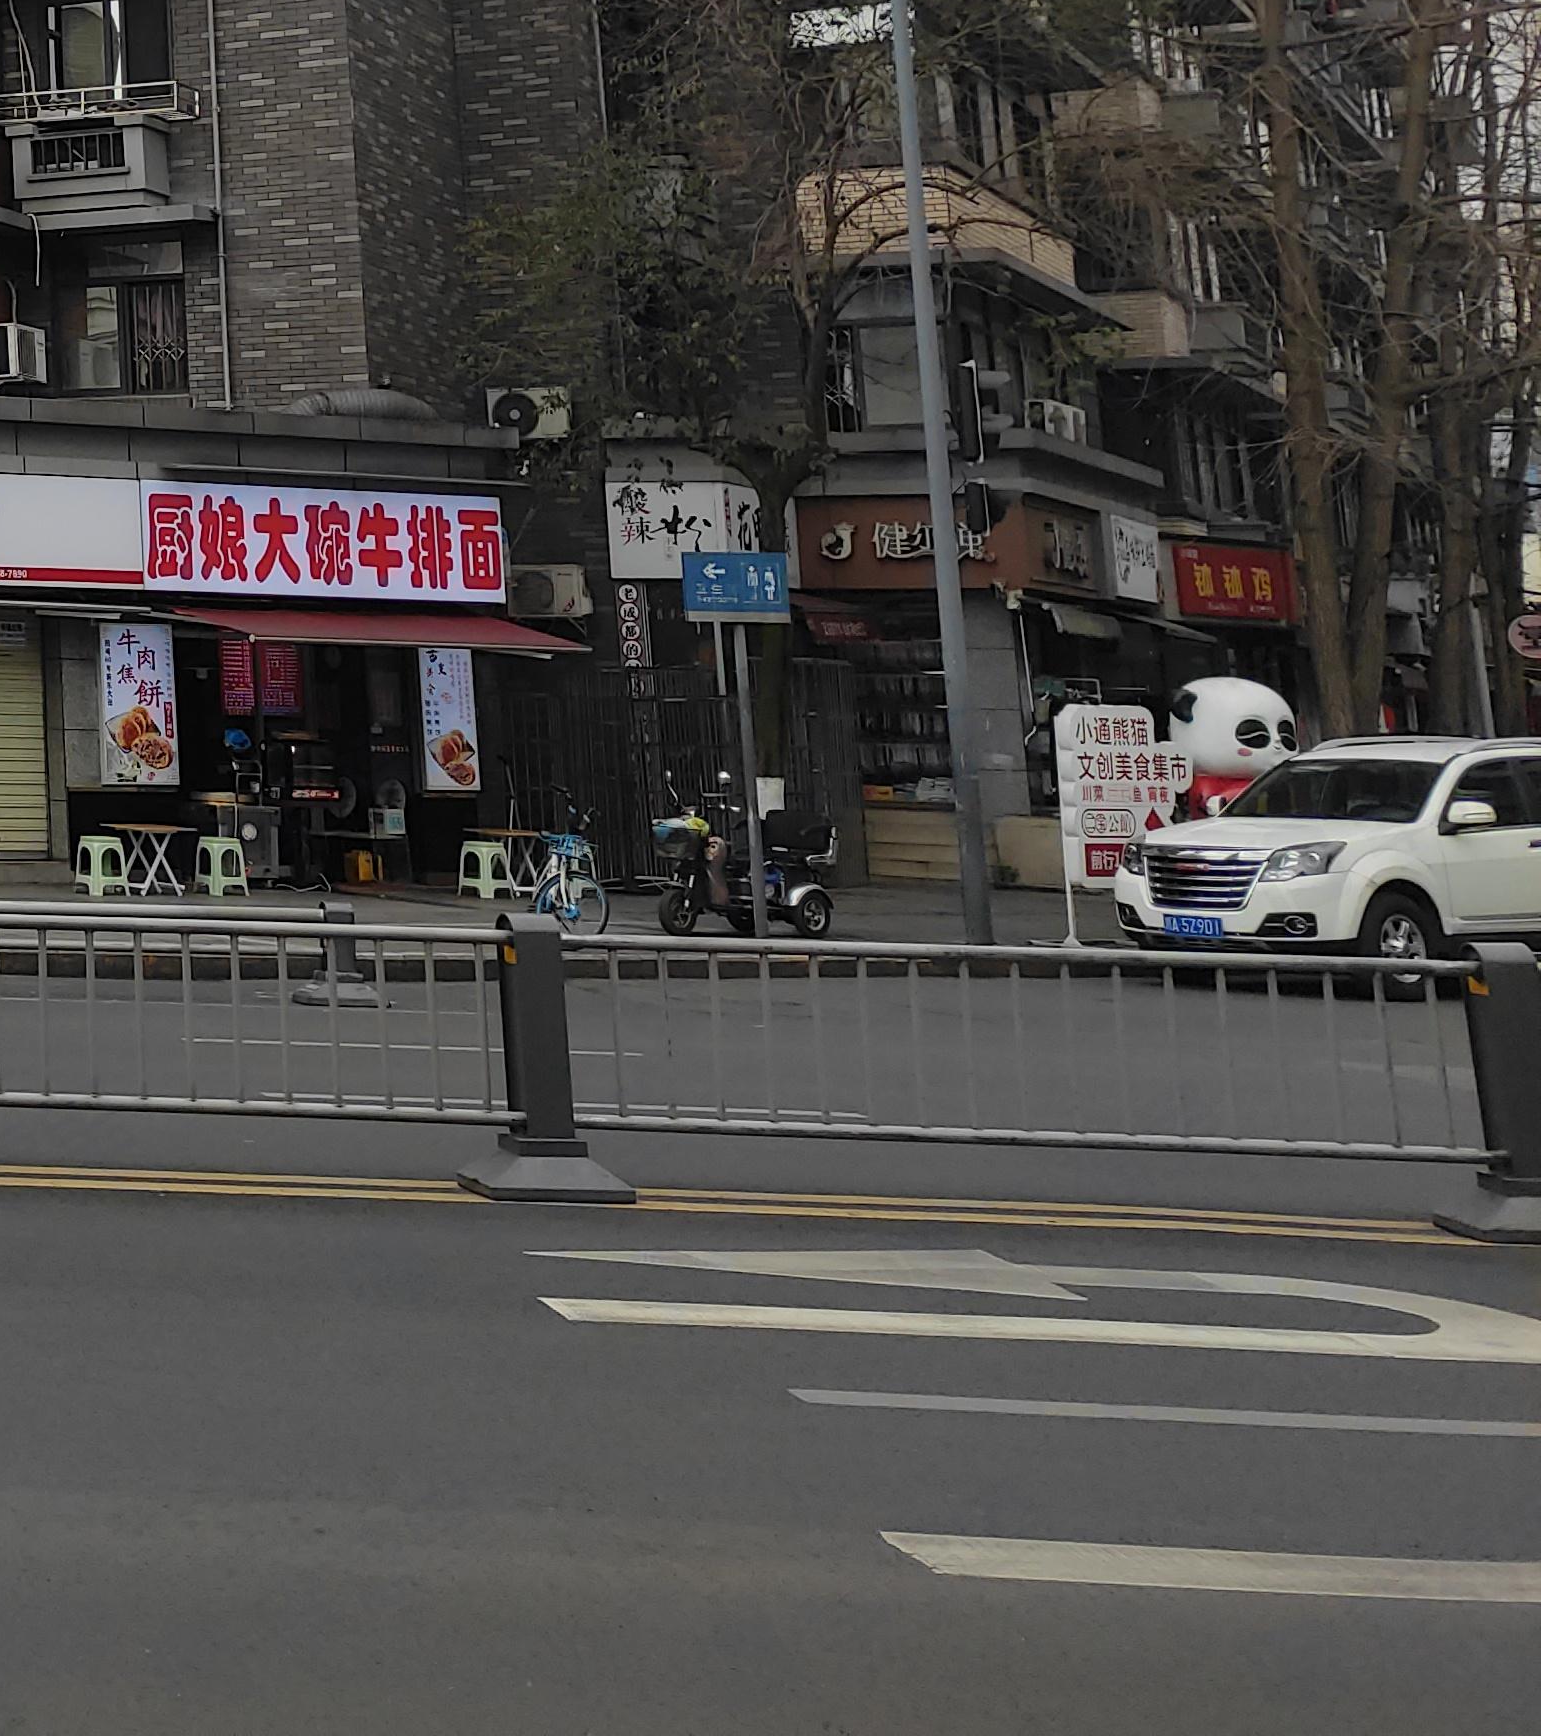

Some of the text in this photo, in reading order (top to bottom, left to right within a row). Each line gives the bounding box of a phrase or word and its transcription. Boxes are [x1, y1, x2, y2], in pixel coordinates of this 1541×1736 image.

[147, 492, 502, 591] 厨娘大碗牛排面
[1076, 716, 1149, 746] 小通熊猫
[1077, 751, 1187, 782] 文创美食集市
[1090, 850, 1121, 871] 前行
